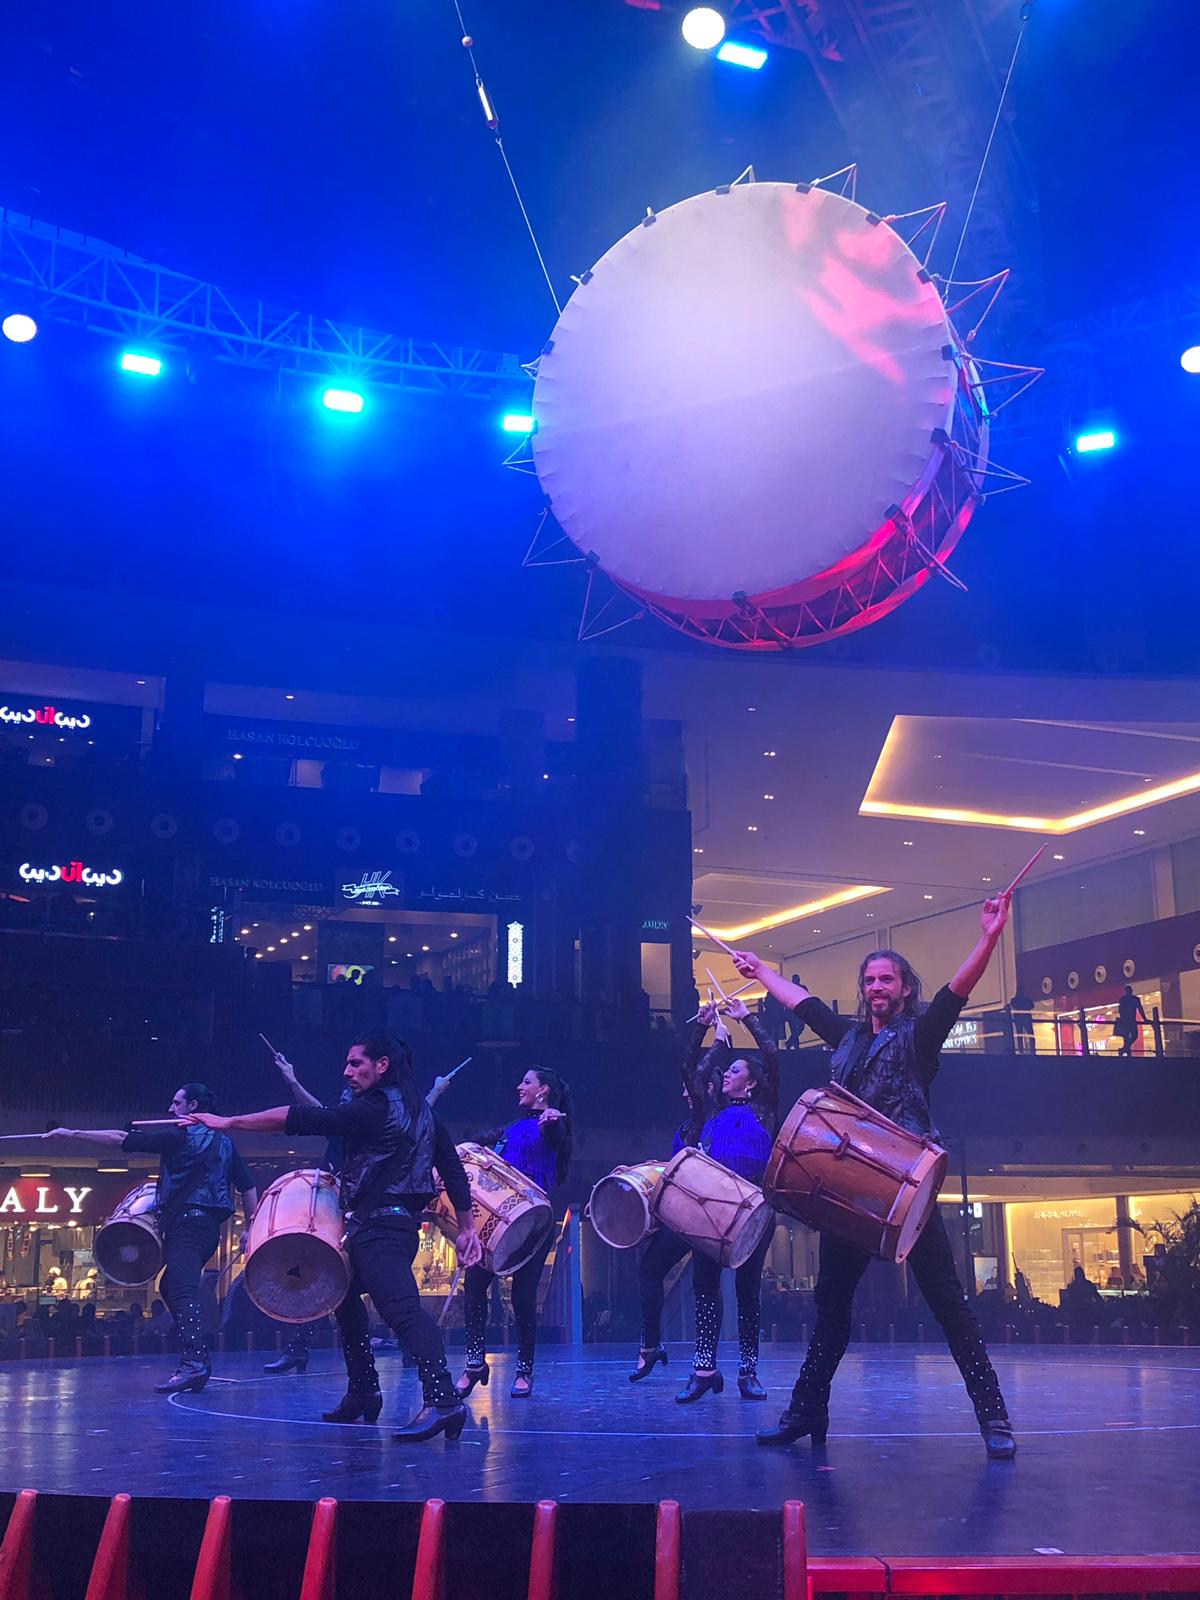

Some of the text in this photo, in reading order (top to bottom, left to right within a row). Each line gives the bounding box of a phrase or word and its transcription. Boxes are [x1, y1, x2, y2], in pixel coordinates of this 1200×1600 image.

[227, 729, 275, 743] HASAN
[209, 876, 249, 889] HASAN
[0, 1186, 93, 1213] ALY
